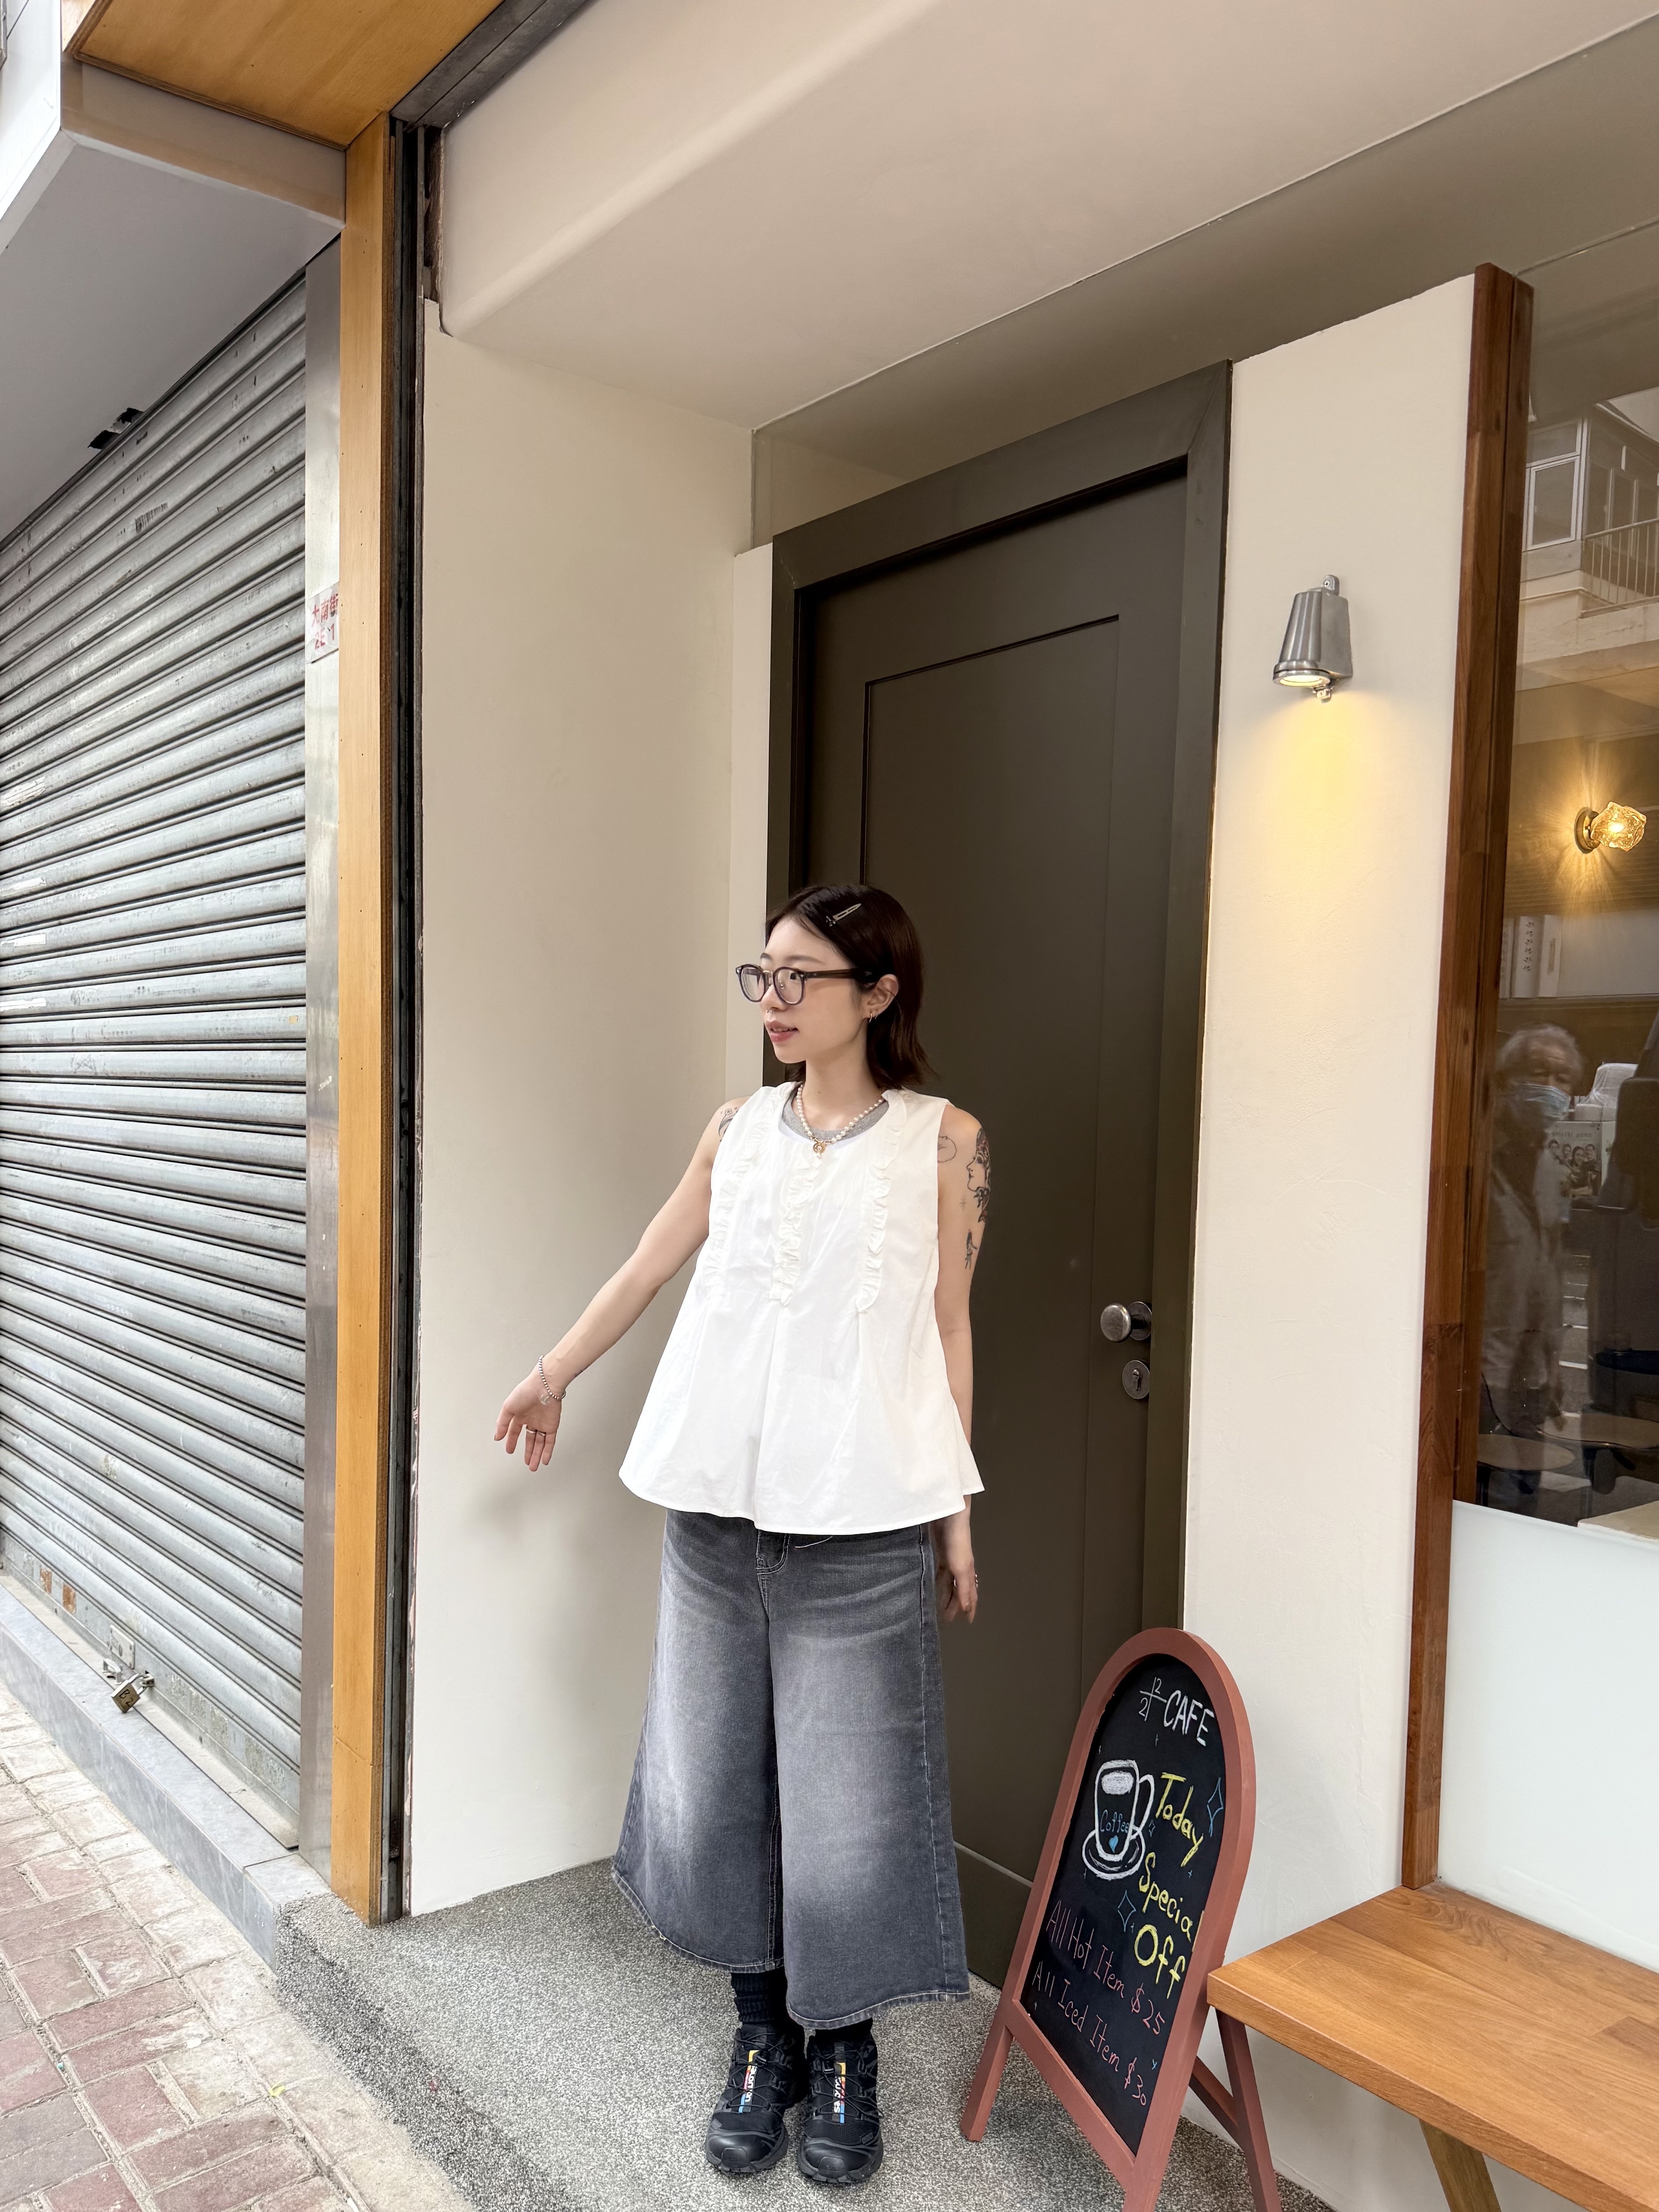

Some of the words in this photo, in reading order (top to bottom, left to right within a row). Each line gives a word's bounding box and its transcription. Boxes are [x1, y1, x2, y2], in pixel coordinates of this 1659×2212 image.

[1163, 1690, 1215, 1747] CAFE
[1100, 1810, 1130, 1833] Coffee
[1155, 1772, 1204, 1867] Today
[1046, 1900, 1071, 1949] All
[1067, 1918, 1094, 1969] Hot
[1094, 1945, 1124, 1998] Item
[1135, 1924, 1185, 1999] Off
[1032, 1961, 1055, 1997] All
[1058, 1979, 1088, 2032] Iced
[1090, 2015, 1118, 2072] Item
